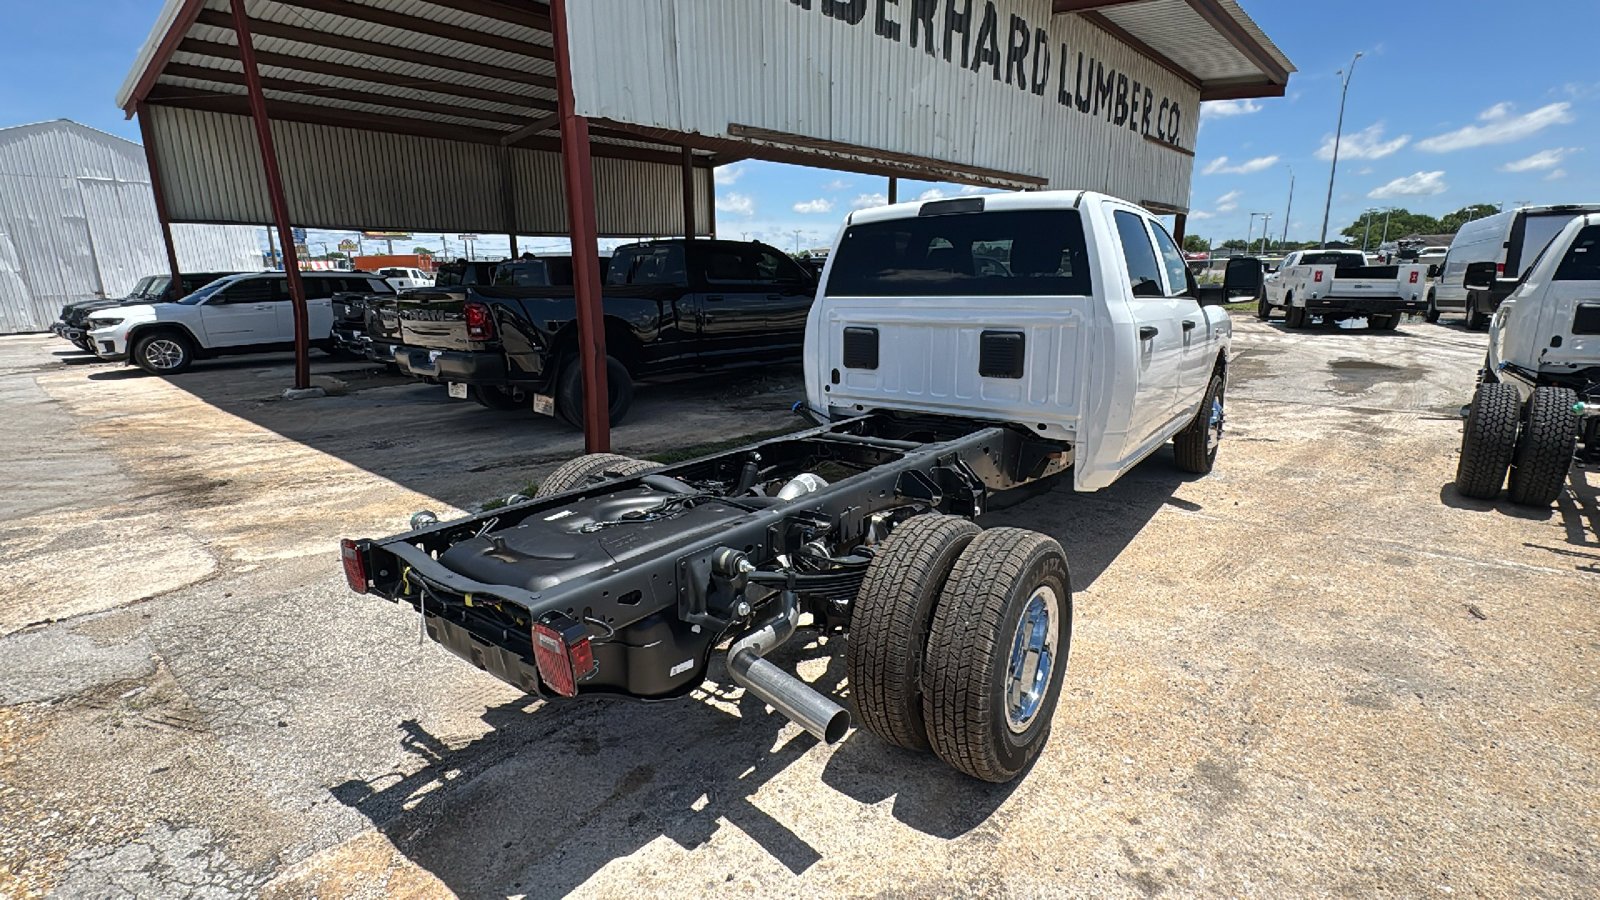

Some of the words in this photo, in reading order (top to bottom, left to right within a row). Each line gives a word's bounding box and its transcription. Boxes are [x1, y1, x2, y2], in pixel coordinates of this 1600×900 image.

[789, 0, 1050, 96] ERHARD
[1057, 42, 1153, 137] LUMBER
[1157, 101, 1180, 147] CO.
[409, 309, 445, 321] RAM
